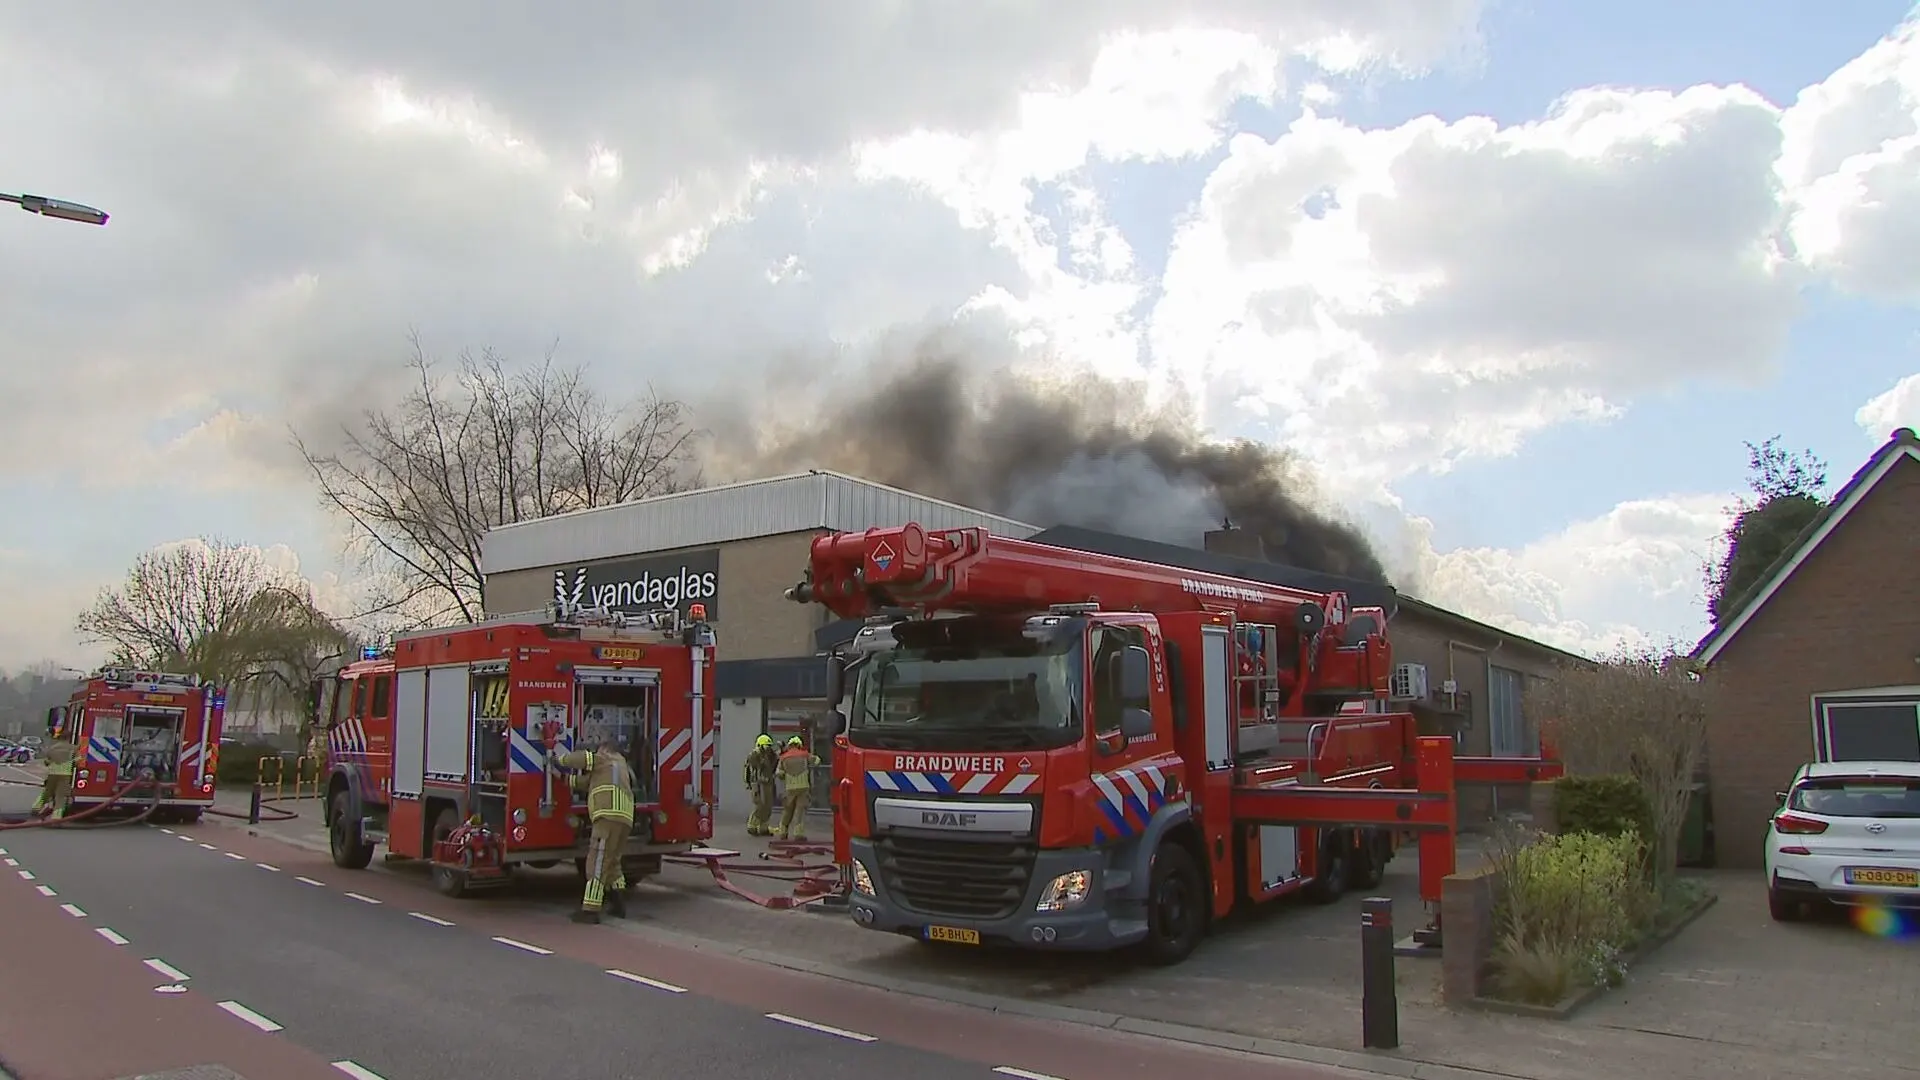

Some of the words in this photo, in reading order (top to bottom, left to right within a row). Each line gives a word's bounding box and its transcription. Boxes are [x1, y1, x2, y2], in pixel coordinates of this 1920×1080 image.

[591, 566, 716, 609] vandaglas
[1181, 578, 1238, 599] BRANDWEER
[518, 681, 567, 689] BRANDWEER
[895, 755, 1005, 772] BRANDWEER
[922, 811, 977, 826] DAF
[932, 927, 976, 942] 85-BHL-7
